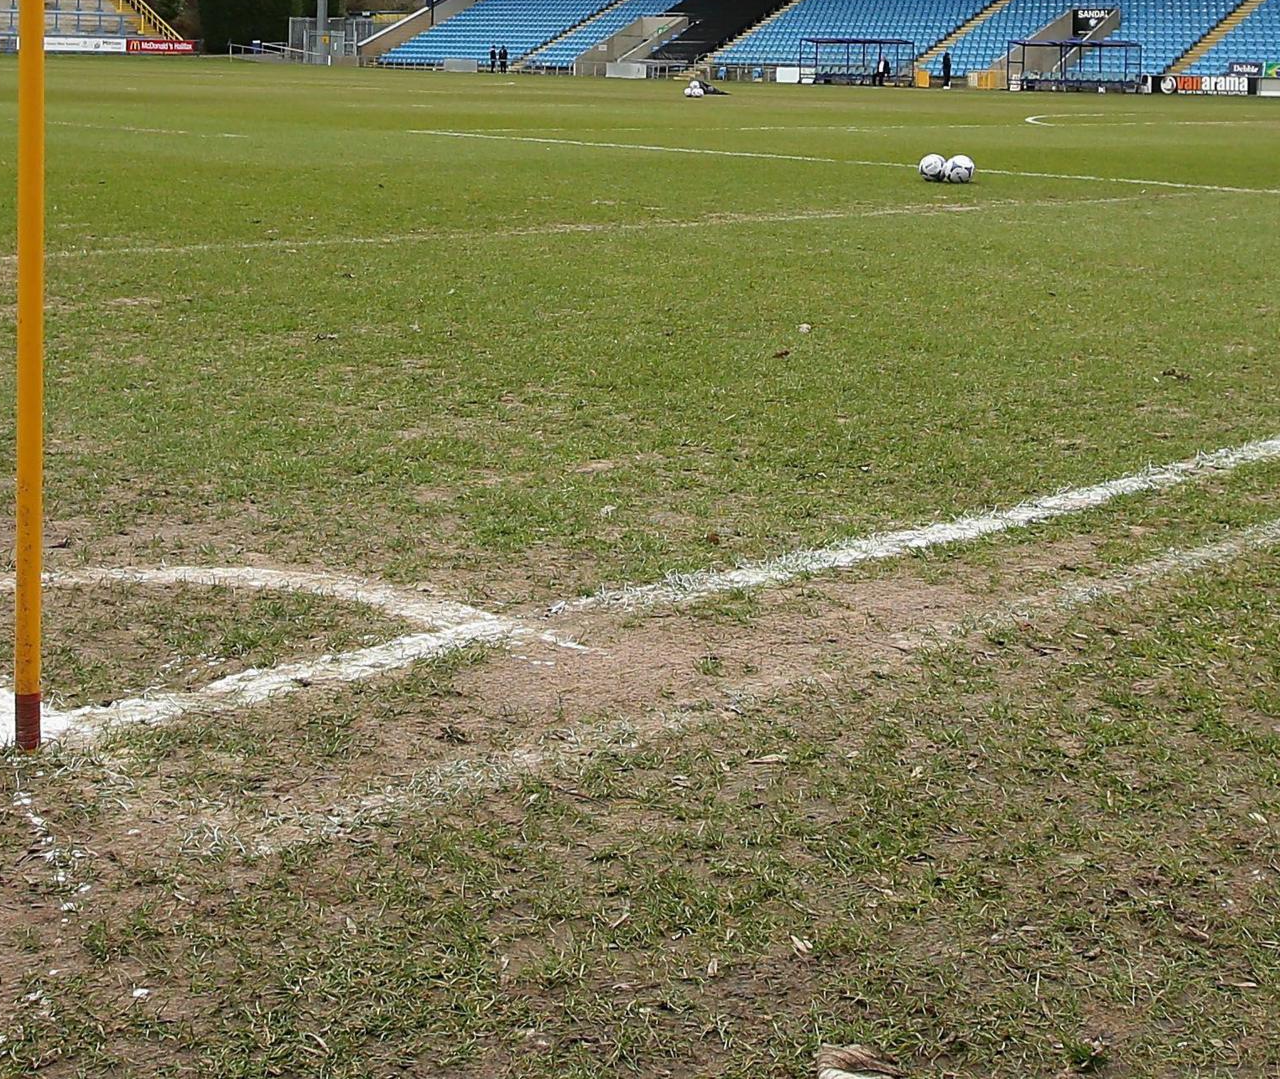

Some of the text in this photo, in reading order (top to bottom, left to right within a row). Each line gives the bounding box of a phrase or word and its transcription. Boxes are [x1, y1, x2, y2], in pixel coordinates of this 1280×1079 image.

[1077, 10, 1109, 19] SANDAL
[141, 41, 173, 50] McDonald's
[1177, 76, 1248, 91] vanarama
